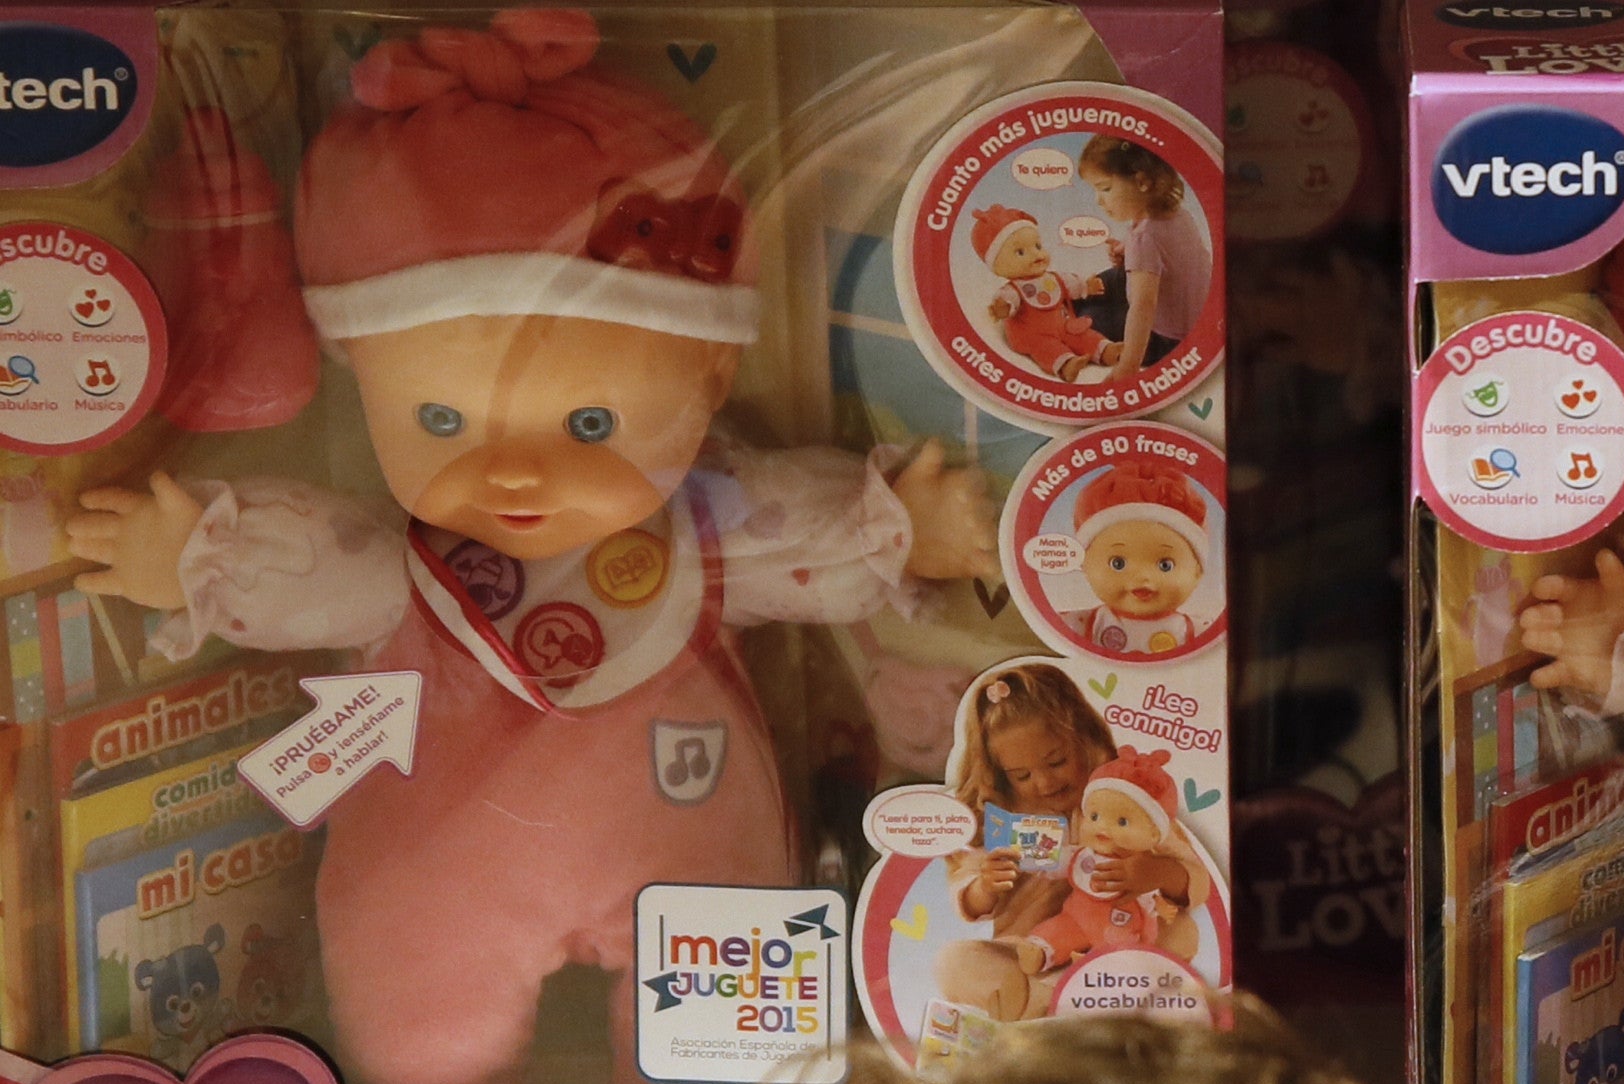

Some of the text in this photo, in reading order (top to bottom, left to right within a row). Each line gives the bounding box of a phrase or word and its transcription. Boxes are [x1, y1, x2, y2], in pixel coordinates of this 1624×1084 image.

[1446, 6, 1613, 19] vtech
[927, 107, 1165, 231] Cuanto más juguemos...
[1017, 163, 1068, 177] Te quiero
[1442, 151, 1618, 197] vtech
[1063, 227, 1106, 239] Te quiero
[0, 231, 107, 272] scubre
[0, 331, 63, 343] imbólico
[72, 331, 146, 344] Emociones
[1444, 319, 1598, 373] Descubre
[951, 336, 1203, 413] antes aprenderé a hablar
[0, 399, 58, 412] abulario
[75, 398, 126, 412] Música
[1426, 422, 1547, 438] Juego simbólico
[1032, 434, 1199, 501] Más de 80 frases
[1450, 493, 1538, 506] Vocabulario
[1555, 491, 1606, 506] Música
[1039, 538, 1069, 548] Mami,
[1142, 684, 1198, 718] ¡Lee
[91, 666, 296, 771] animales
[269, 684, 381, 777] ¡PRUÉBAME!
[1105, 704, 1221, 753] conmigo!
[335, 730, 389, 777] a hablar!
[153, 758, 239, 810] comid
[276, 769, 313, 799] Pulsa
[328, 749, 339, 761] y
[886, 825, 964, 836] tenedor, cuchara,
[911, 816, 933, 824] para
[1286, 821, 1404, 886] Litt
[137, 829, 303, 921] mi casa
[1251, 877, 1404, 952] Lov
[670, 927, 817, 977] mejor
[1571, 926, 1617, 1000] mi
[671, 972, 818, 1000] JUGUETE
[1084, 972, 1183, 988] Libros de
[1071, 993, 1197, 1010] vocabulario
[737, 1004, 819, 1034] 2015
[670, 1037, 818, 1052] Asociación Española de
[671, 1049, 739, 1061] Fabricantes
[744, 1050, 758, 1060] de
